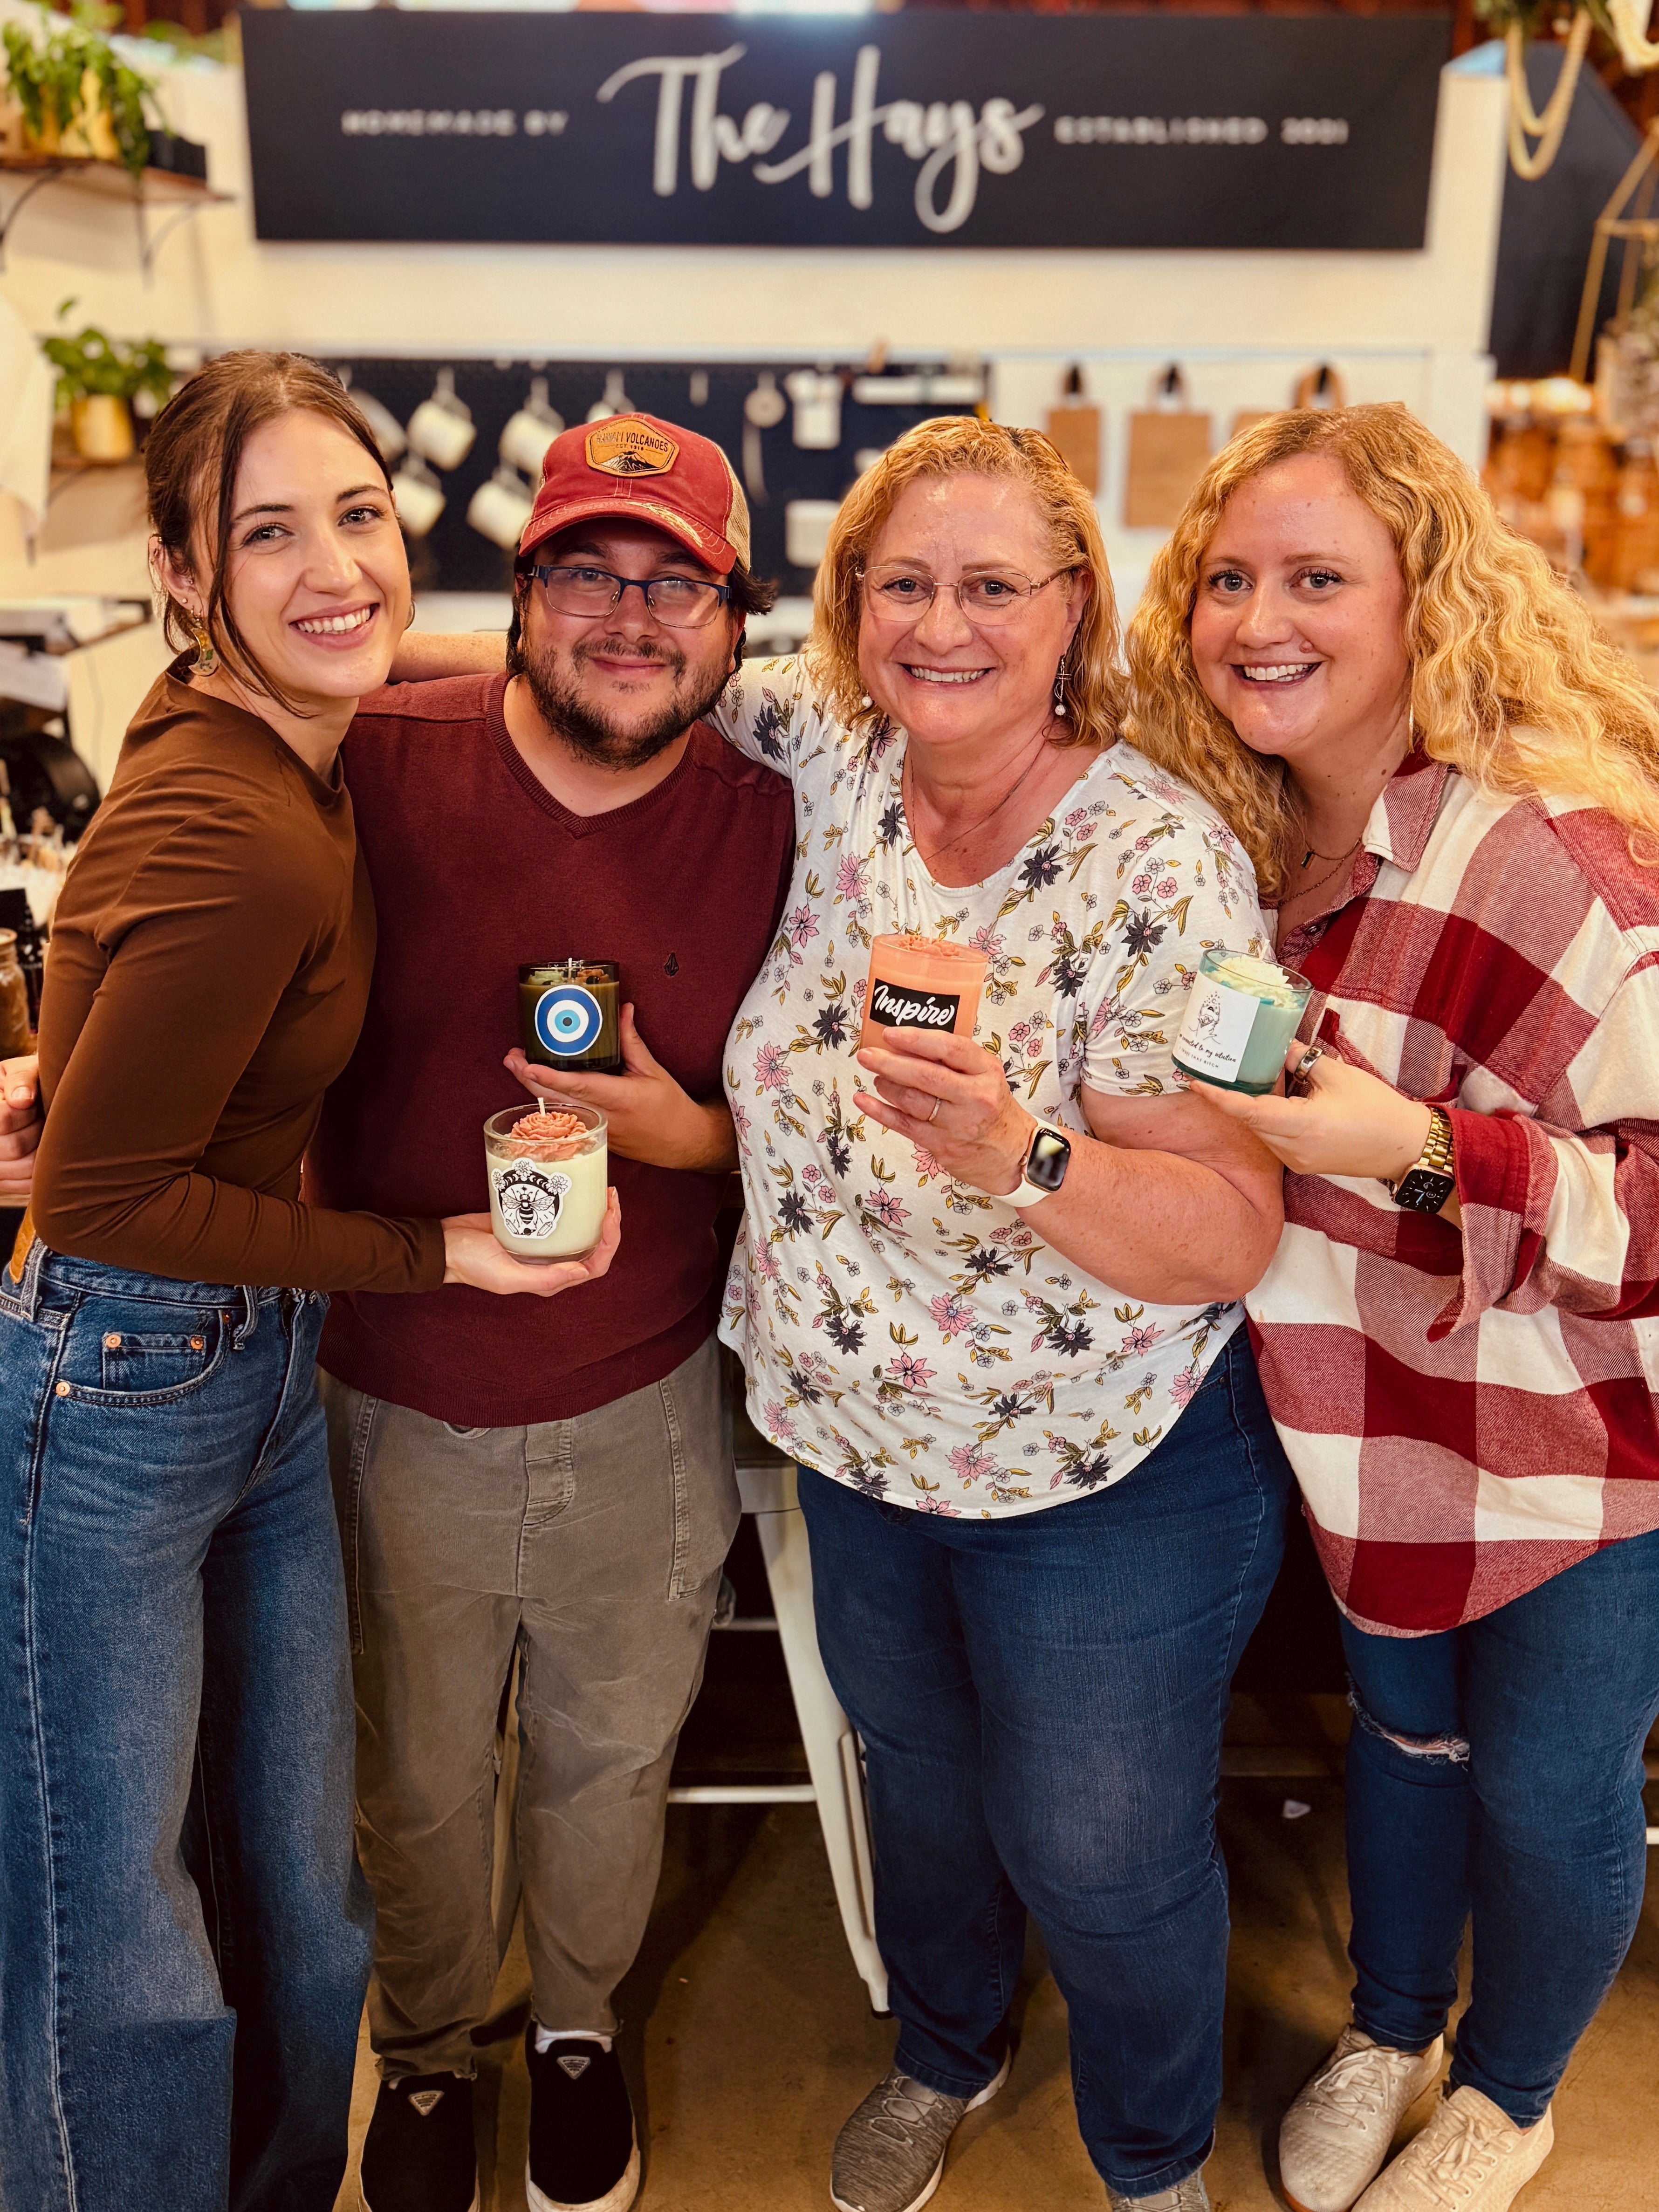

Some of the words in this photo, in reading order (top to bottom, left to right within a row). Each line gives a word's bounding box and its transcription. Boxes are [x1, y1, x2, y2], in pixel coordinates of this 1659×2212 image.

[596, 41, 791, 197] The
[752, 44, 1045, 233] Hays
[626, 432, 668, 452] VOLCANOES
[874, 985, 955, 1026] Inspire
[1205, 1049, 1213, 1058] my
